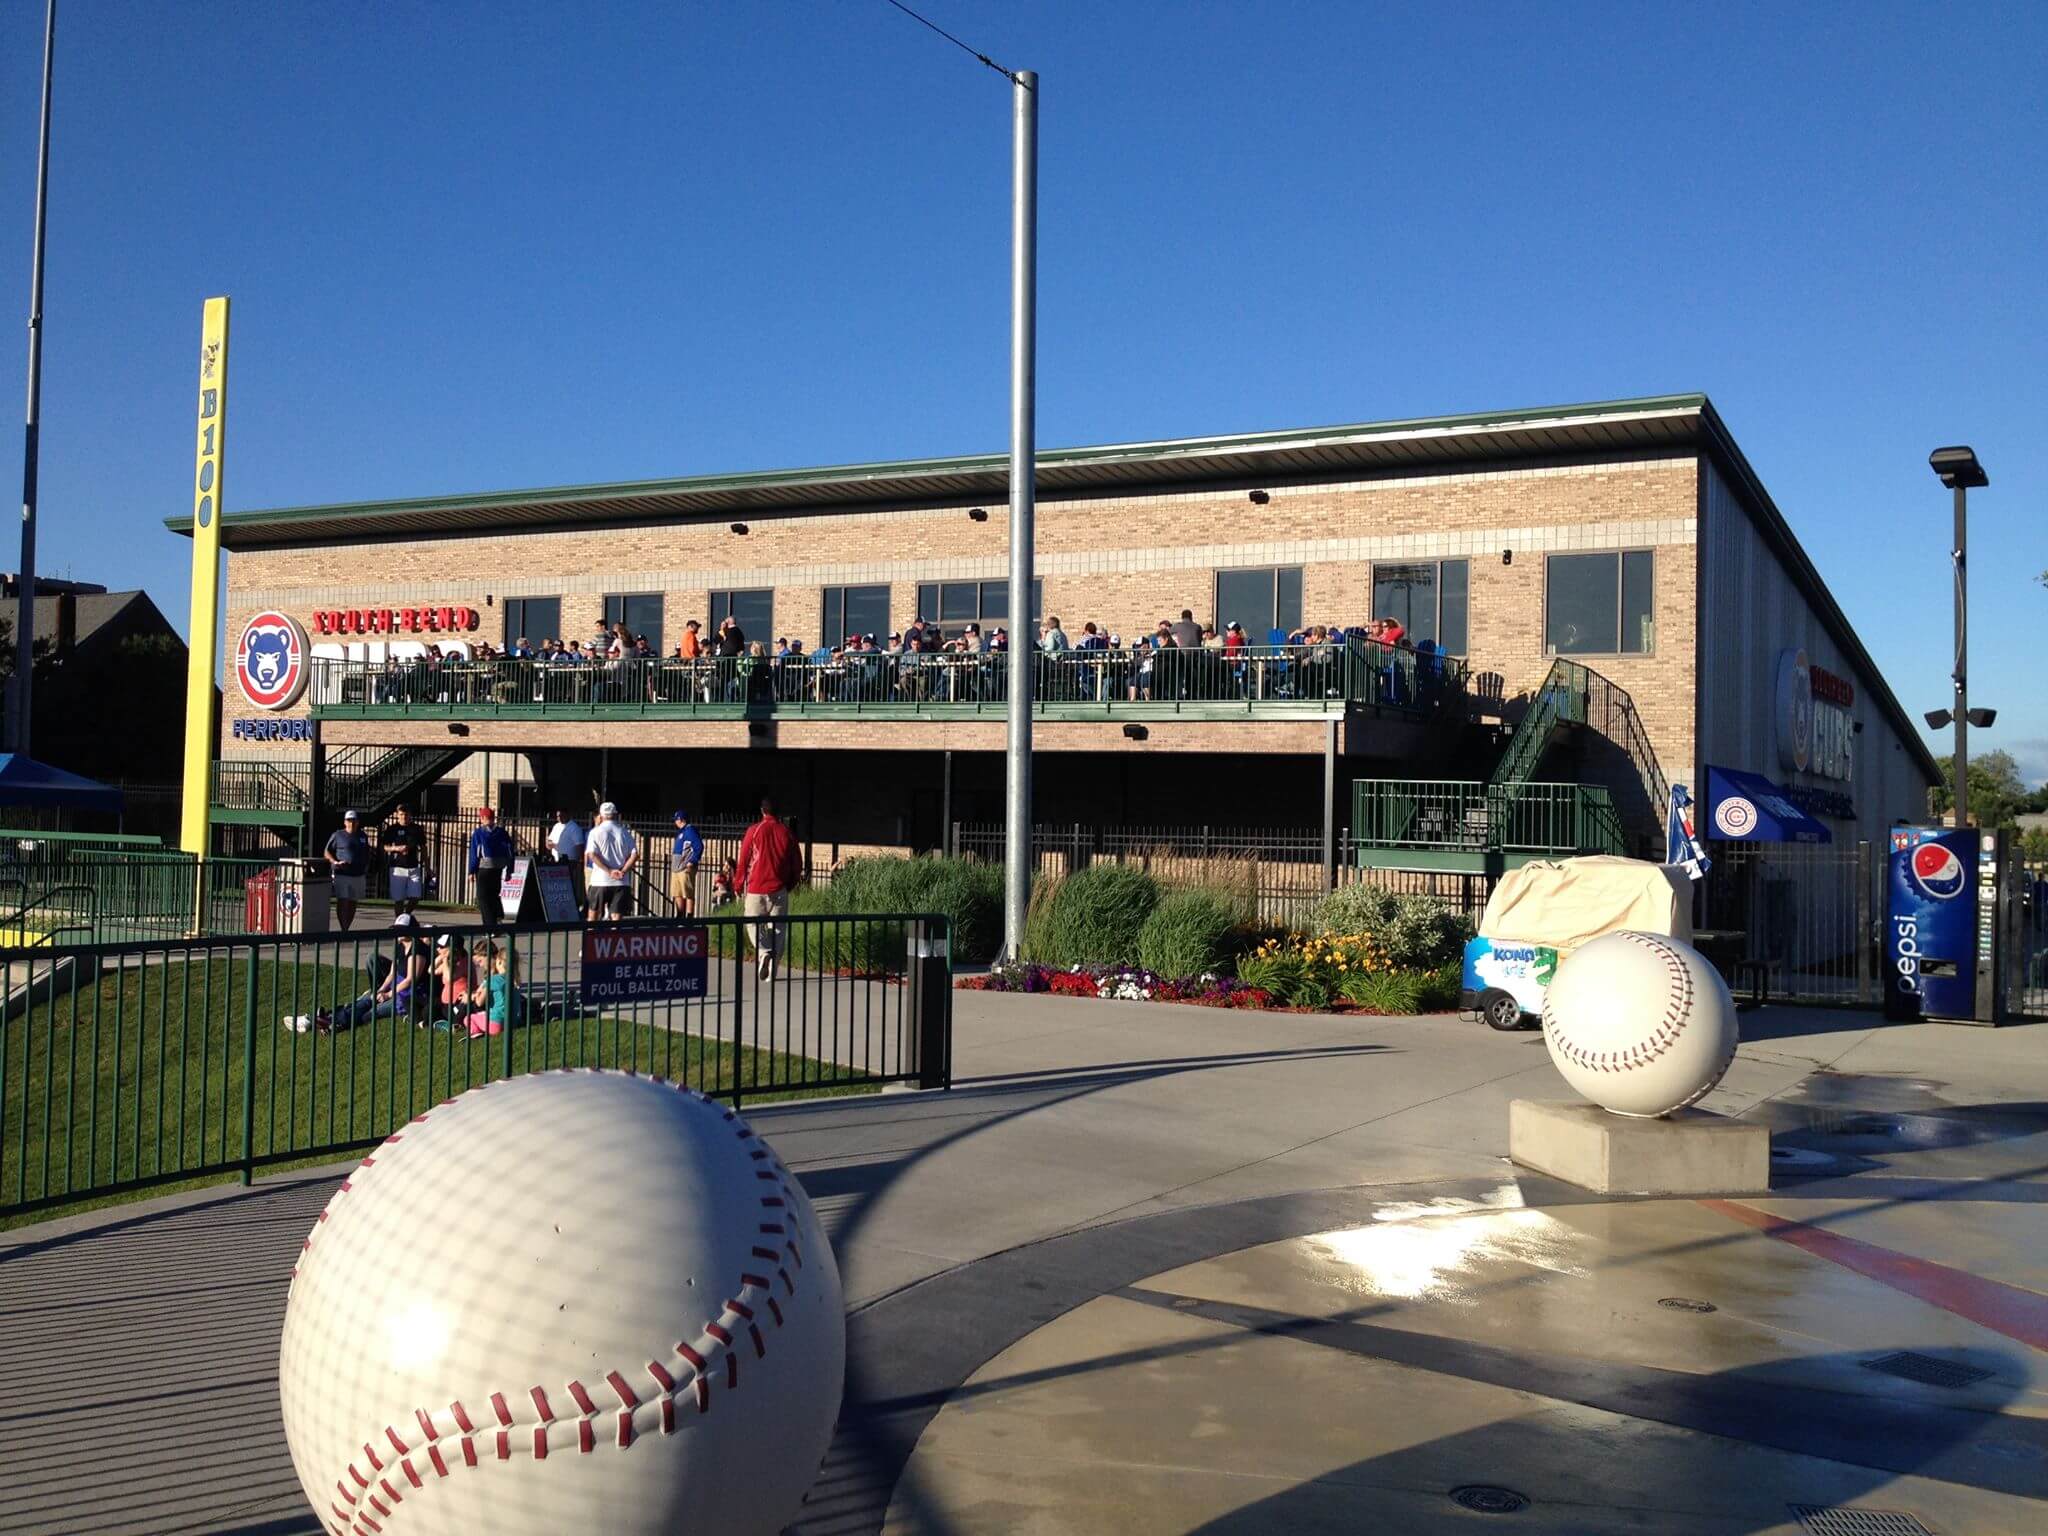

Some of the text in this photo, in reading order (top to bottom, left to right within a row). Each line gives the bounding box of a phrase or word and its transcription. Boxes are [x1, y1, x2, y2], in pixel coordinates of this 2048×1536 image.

[312, 606, 472, 633] SOUTH BEND
[594, 935, 698, 958] WARNING
[1493, 947, 1535, 962] KONA
[1894, 913, 1924, 996] pepsi
[615, 963, 677, 978] BE ALERT
[591, 978, 699, 996] FOUL BALL ZONE
